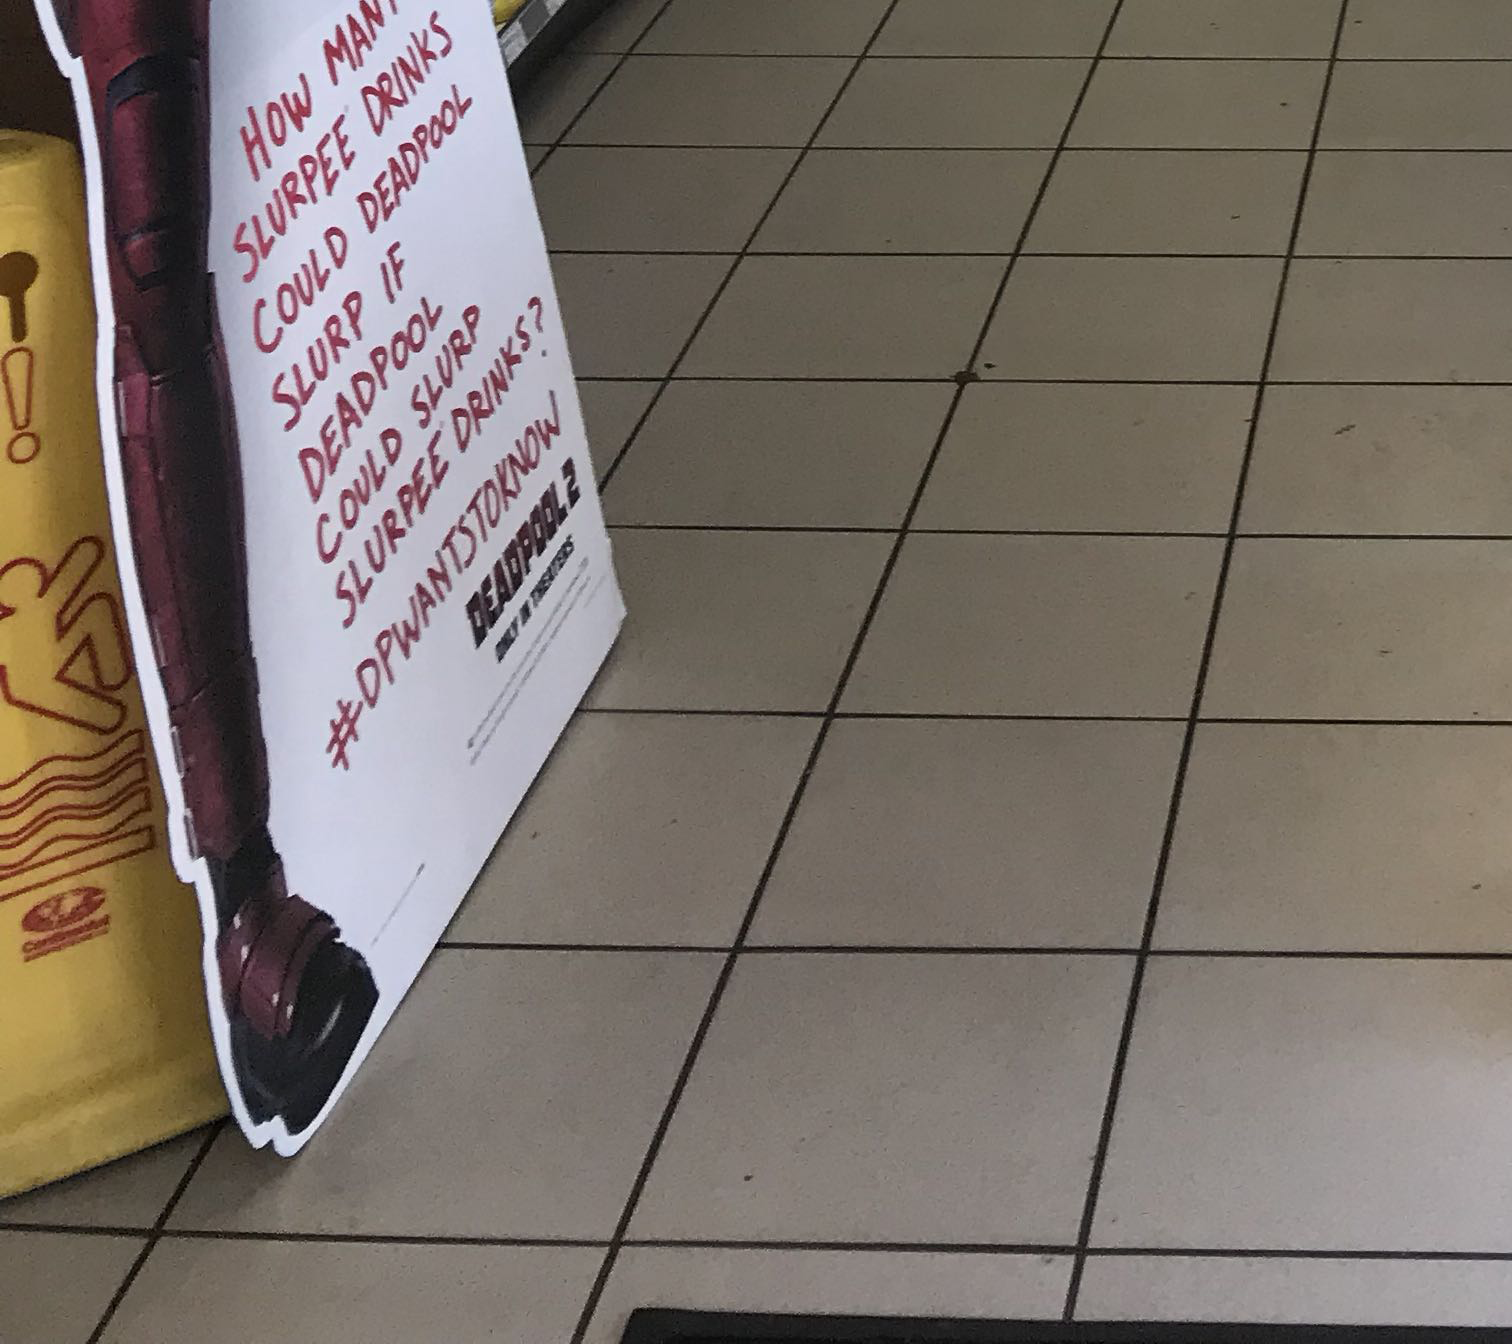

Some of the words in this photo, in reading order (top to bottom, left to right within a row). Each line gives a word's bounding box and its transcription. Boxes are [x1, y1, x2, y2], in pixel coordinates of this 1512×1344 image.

[232, 113, 356, 283] SLURPEE
[360, 10, 453, 137] DRINKS
[239, 72, 312, 182] HOW
[252, 226, 348, 354] COULD
[356, 83, 473, 234] DEADPOOL
[271, 290, 363, 432] SLURP
[379, 240, 405, 304] IF
[298, 296, 444, 504] DEADPOOL
[315, 427, 403, 565] COULD
[410, 304, 482, 430] SLURP
[336, 429, 450, 630] SLURPEE
[450, 296, 549, 454] DRINKS?
[325, 389, 562, 771] #DPWANTSTOKNOW
[465, 480, 569, 650] DEADPOOL
[561, 456, 581, 510] 2
